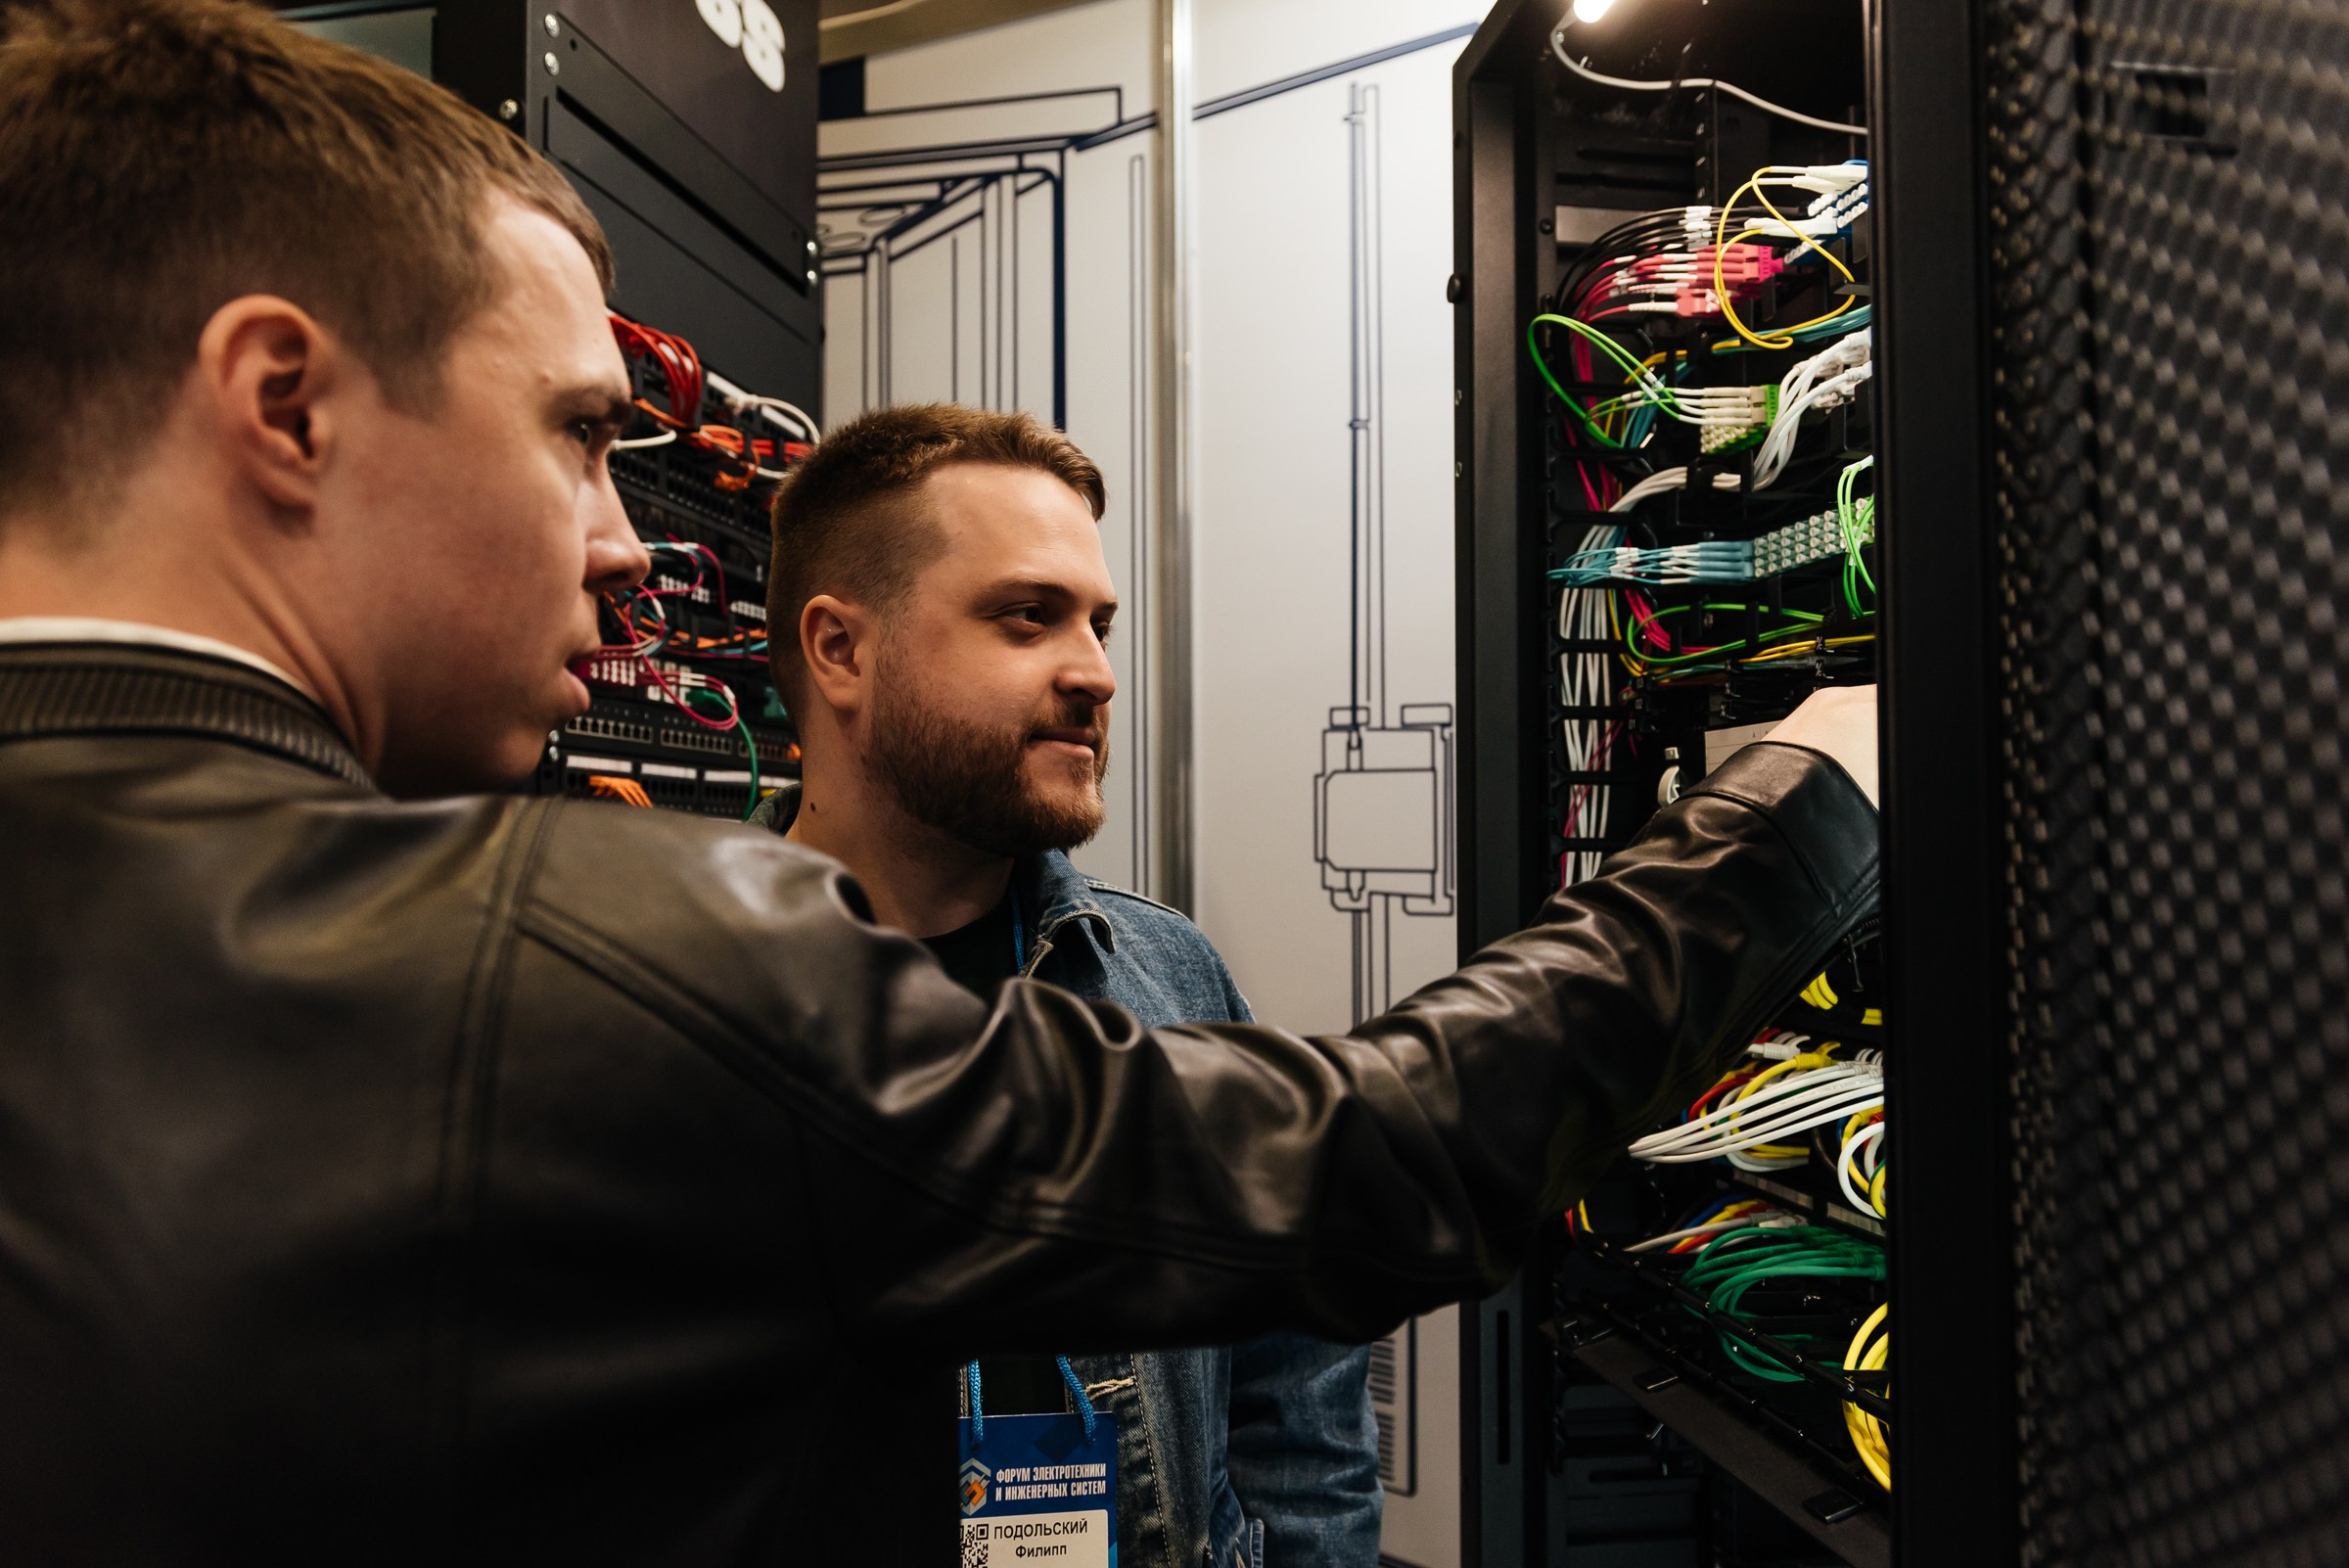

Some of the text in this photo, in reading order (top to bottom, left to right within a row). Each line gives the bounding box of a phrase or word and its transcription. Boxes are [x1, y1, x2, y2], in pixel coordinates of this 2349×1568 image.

[995, 1463, 1106, 1484] ФОРУМ ЭЛЕКТРОТЕХНИКИ
[995, 1480, 1106, 1501] И ИНЖЕНЕРНЫХ СИСТЕМ
[993, 1518, 1087, 1540] ПОДОЛЬСКИЙ
[1015, 1545, 1067, 1558] Филипп
